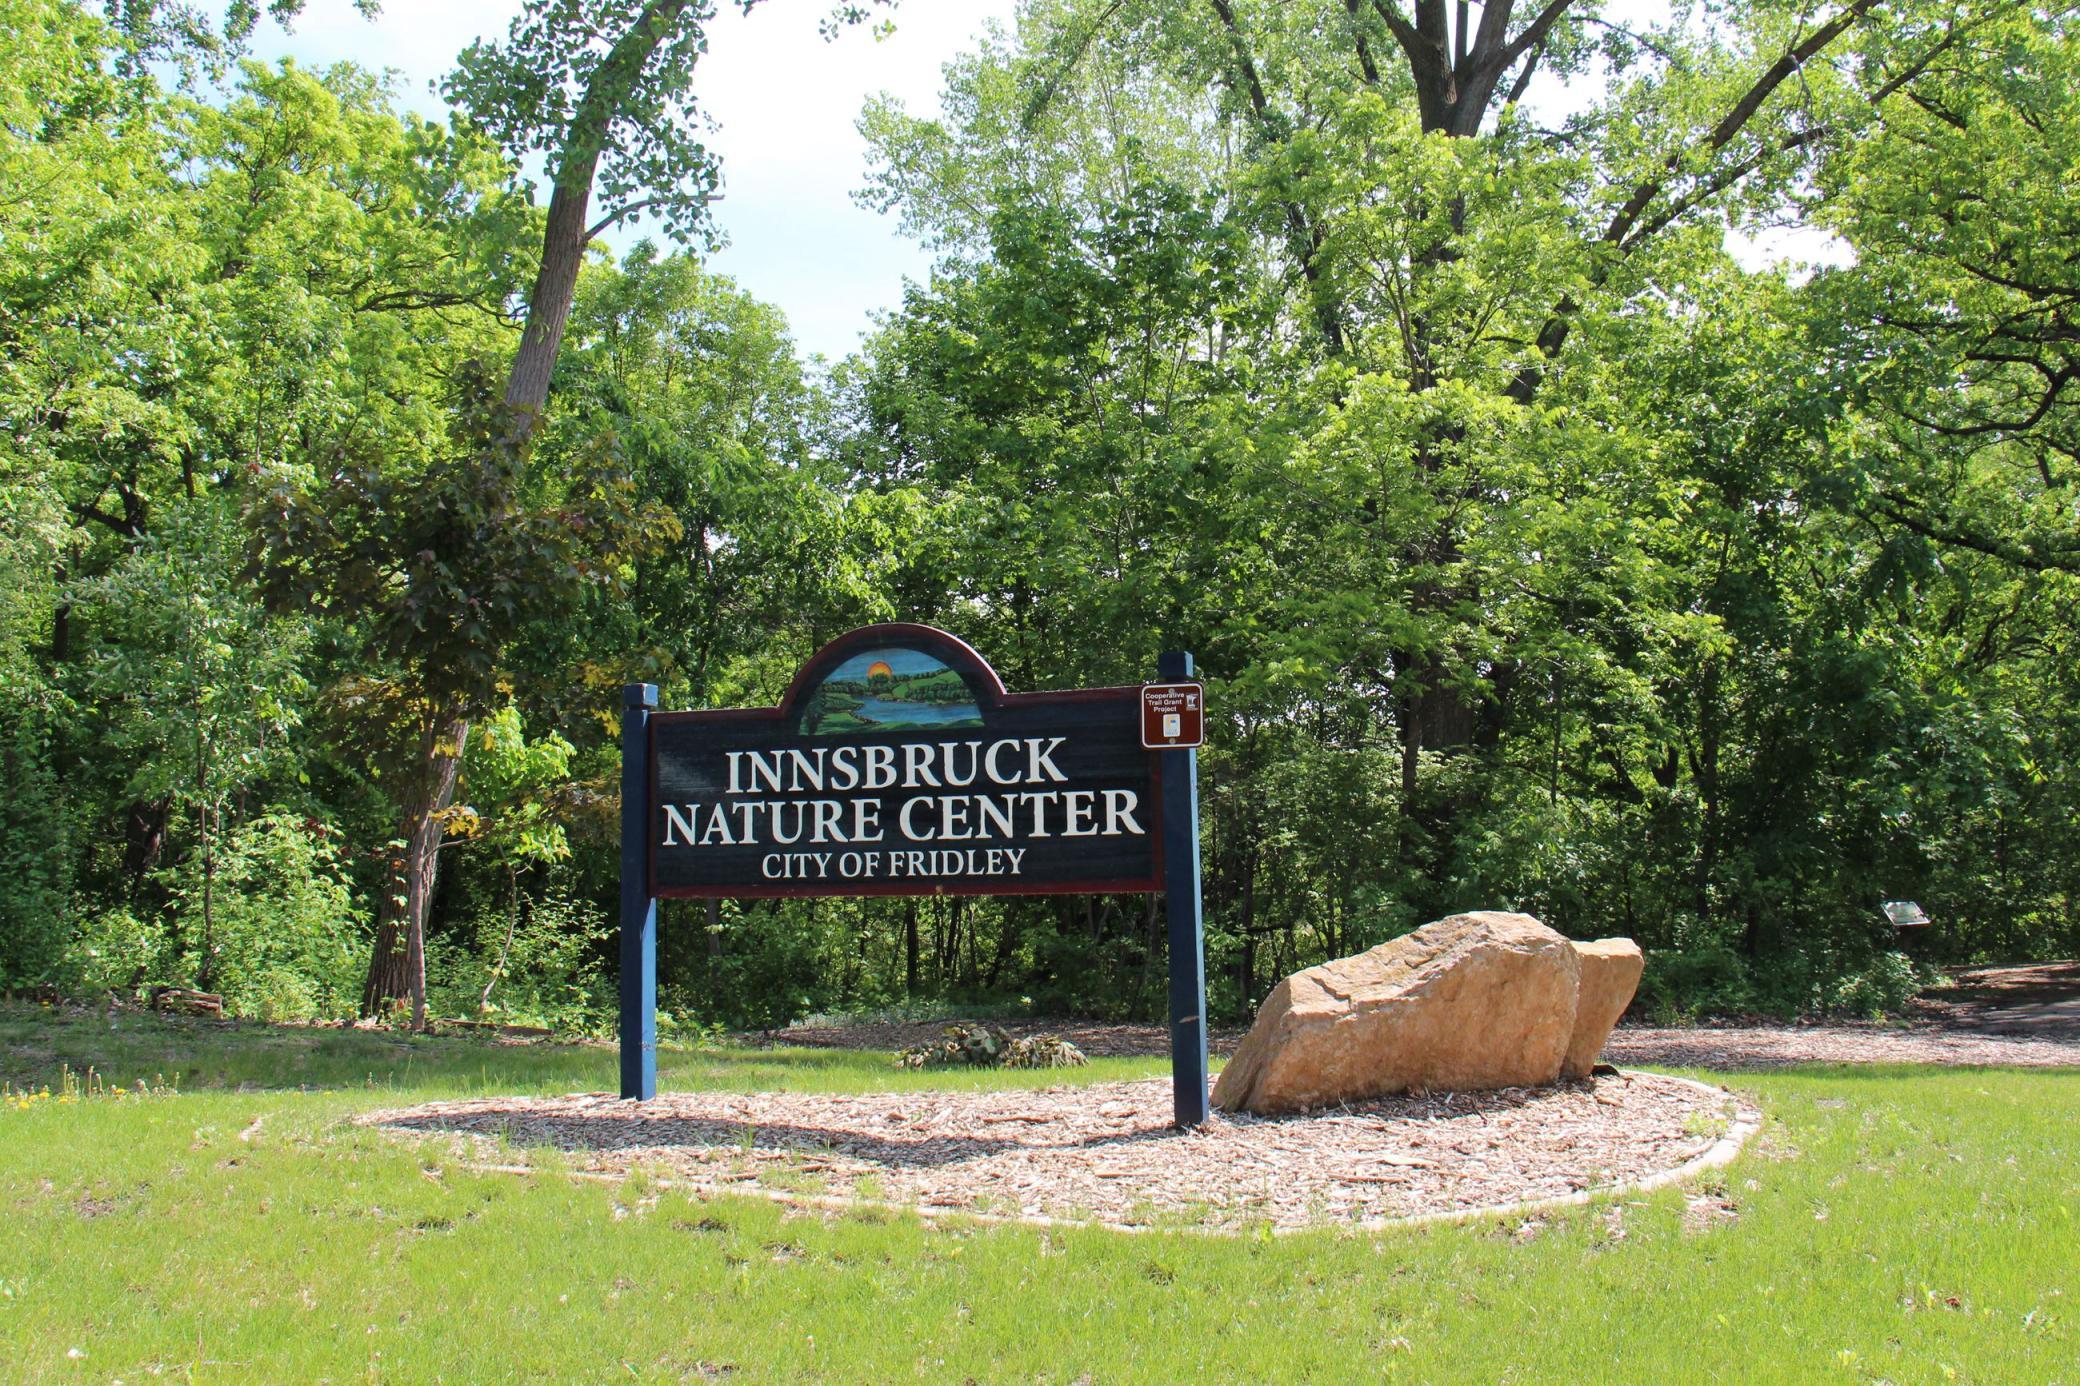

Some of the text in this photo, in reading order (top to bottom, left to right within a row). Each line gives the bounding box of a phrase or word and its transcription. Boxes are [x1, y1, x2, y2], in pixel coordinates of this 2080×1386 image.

[1145, 692, 1185, 700] Cooperative
[725, 736, 1069, 794] INNSBRUCK
[661, 789, 1146, 846] NATURE CENTER
[762, 848, 1026, 879] CITY OF FRIDLEY
